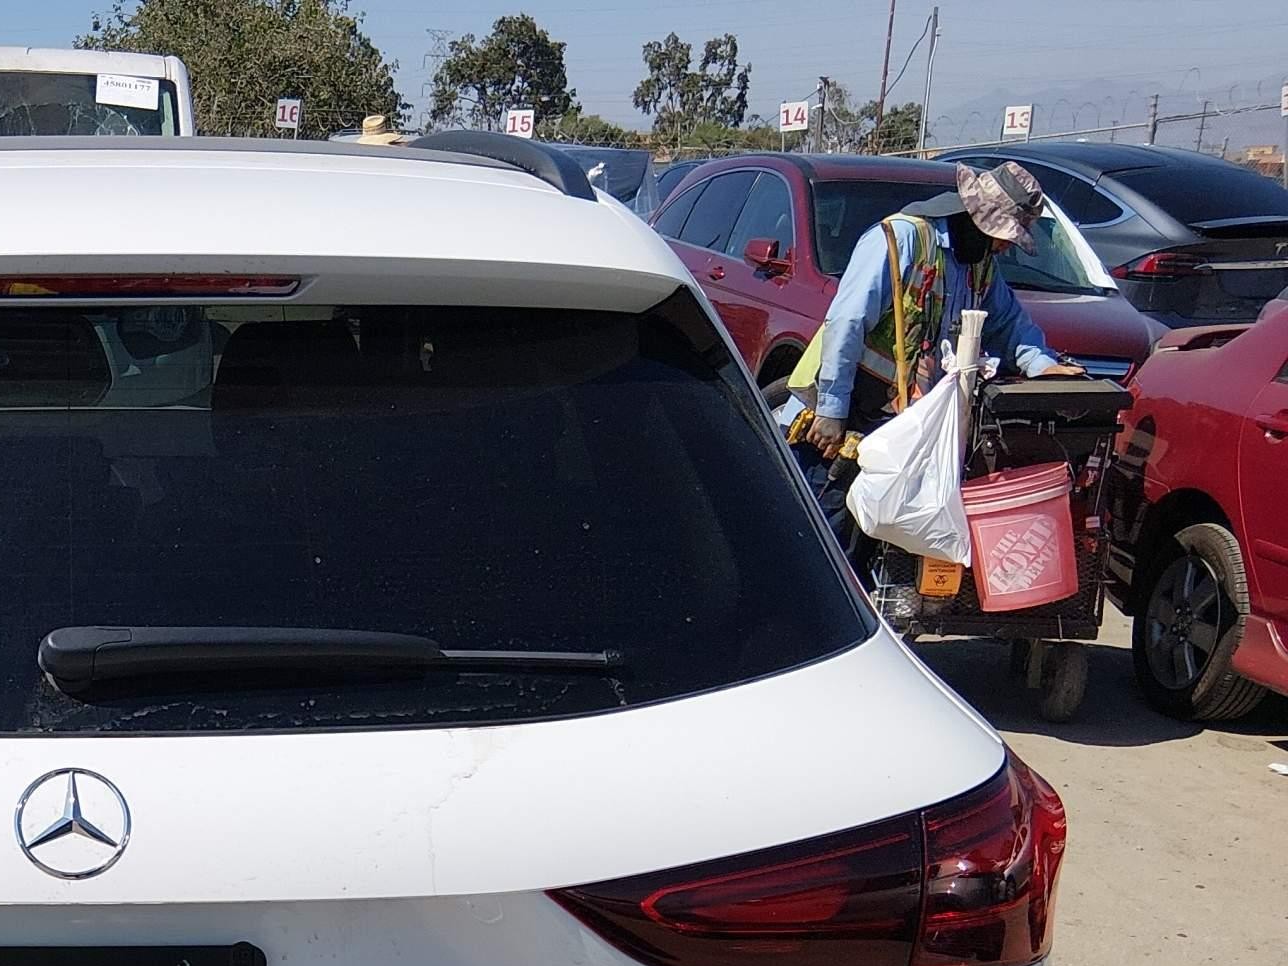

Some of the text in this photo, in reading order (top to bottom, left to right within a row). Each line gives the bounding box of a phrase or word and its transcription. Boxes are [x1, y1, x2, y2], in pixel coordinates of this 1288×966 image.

[278, 105, 298, 123] 16
[781, 107, 806, 126] 14
[1006, 112, 1029, 129] 13
[508, 115, 532, 133] 15
[989, 529, 1020, 560] THE
[988, 518, 1054, 593] HOME
